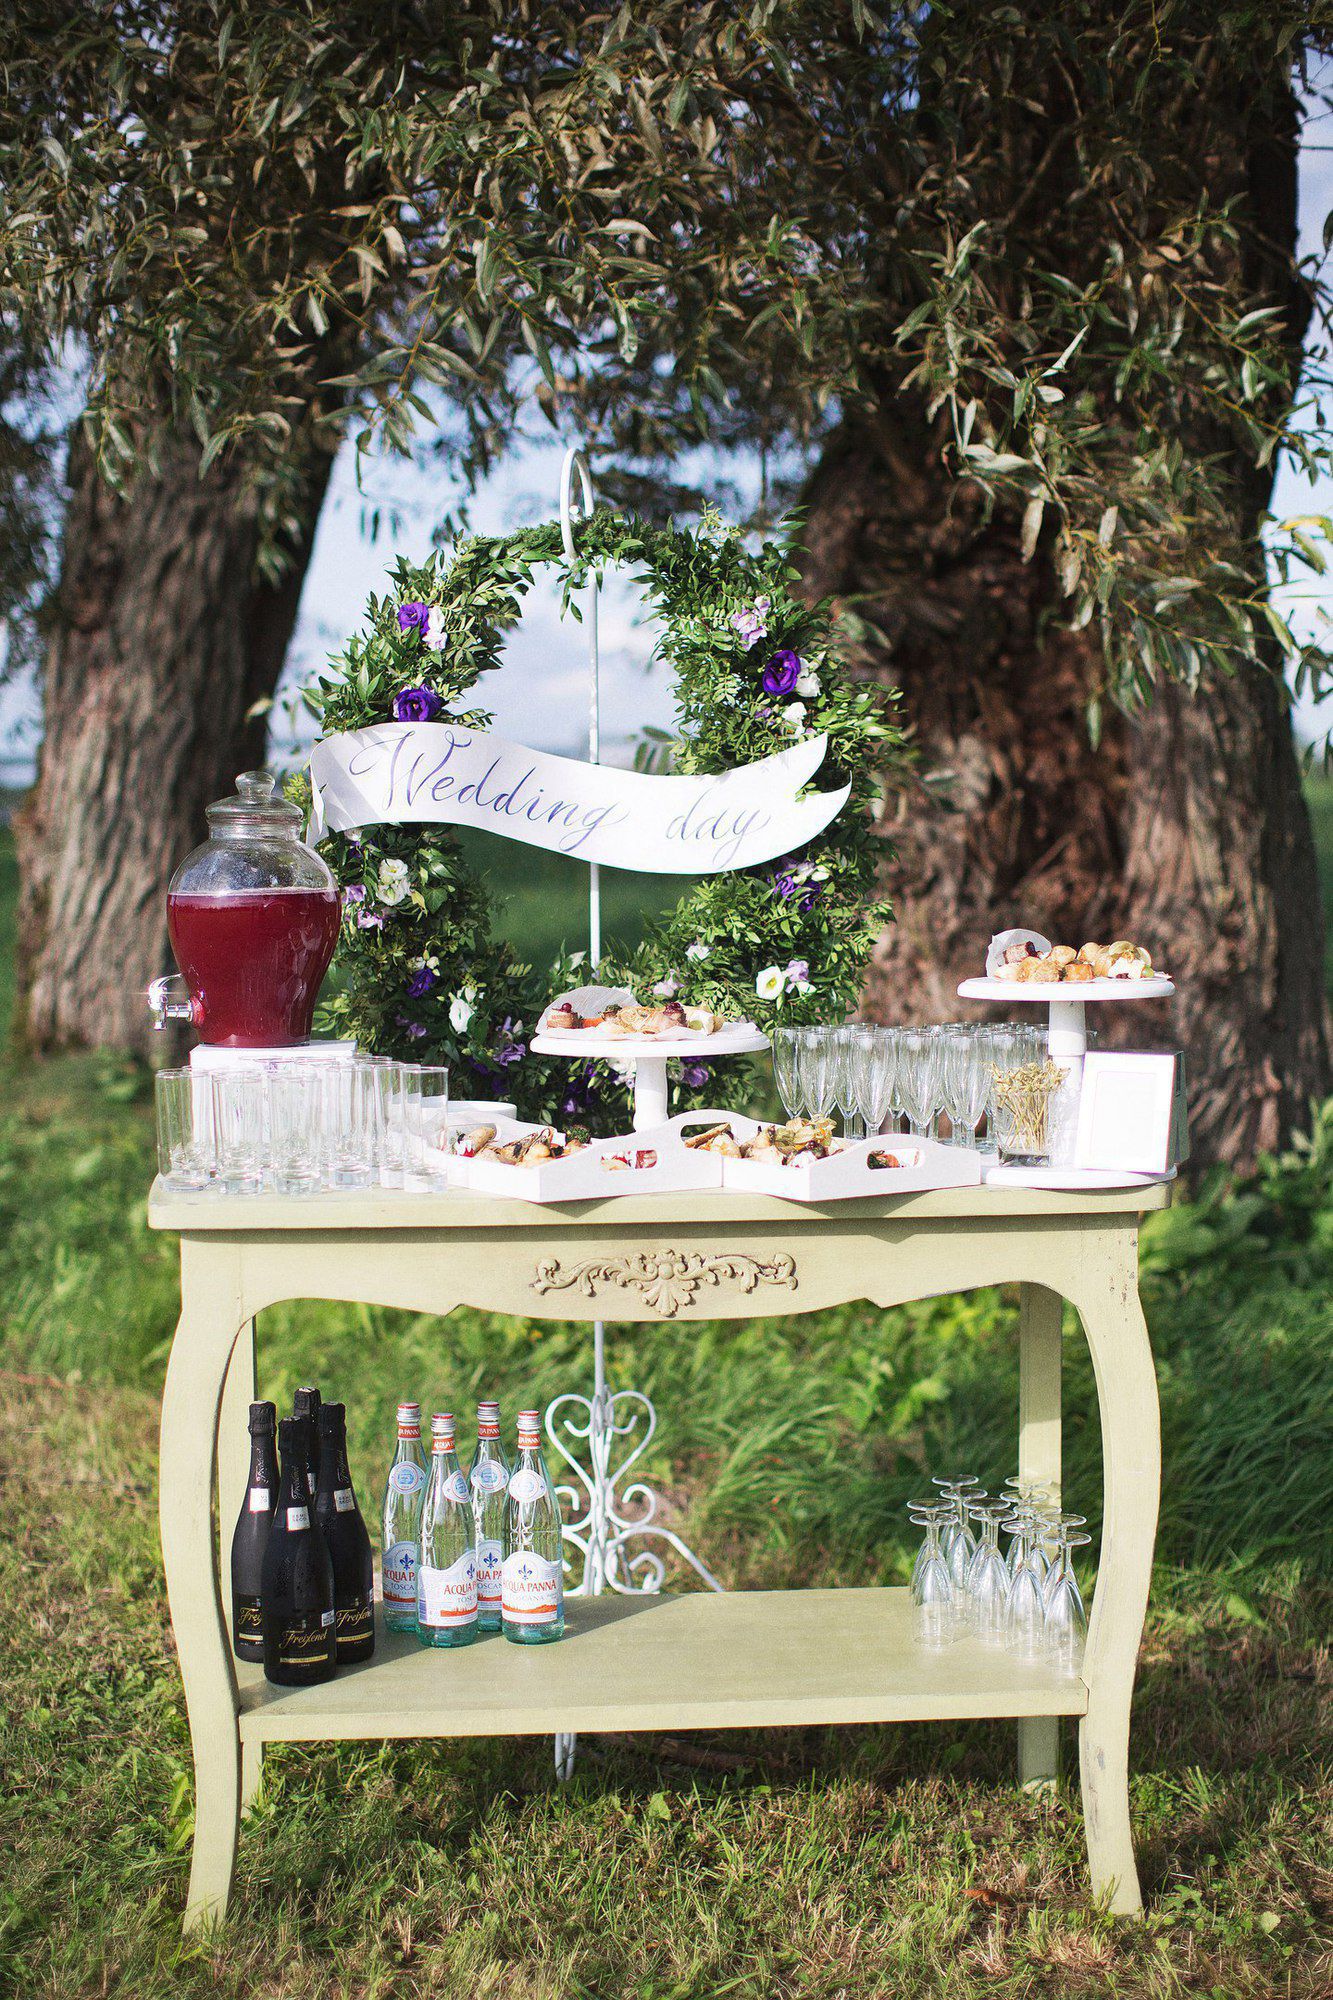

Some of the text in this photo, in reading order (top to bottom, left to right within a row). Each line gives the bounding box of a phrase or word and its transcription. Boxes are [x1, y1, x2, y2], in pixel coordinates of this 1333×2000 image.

[349, 731, 772, 869] Wedding day
[443, 1582, 472, 1596] ACQUA
[527, 1579, 557, 1593] PANNA
[278, 1628, 328, 1649] Freixenet
